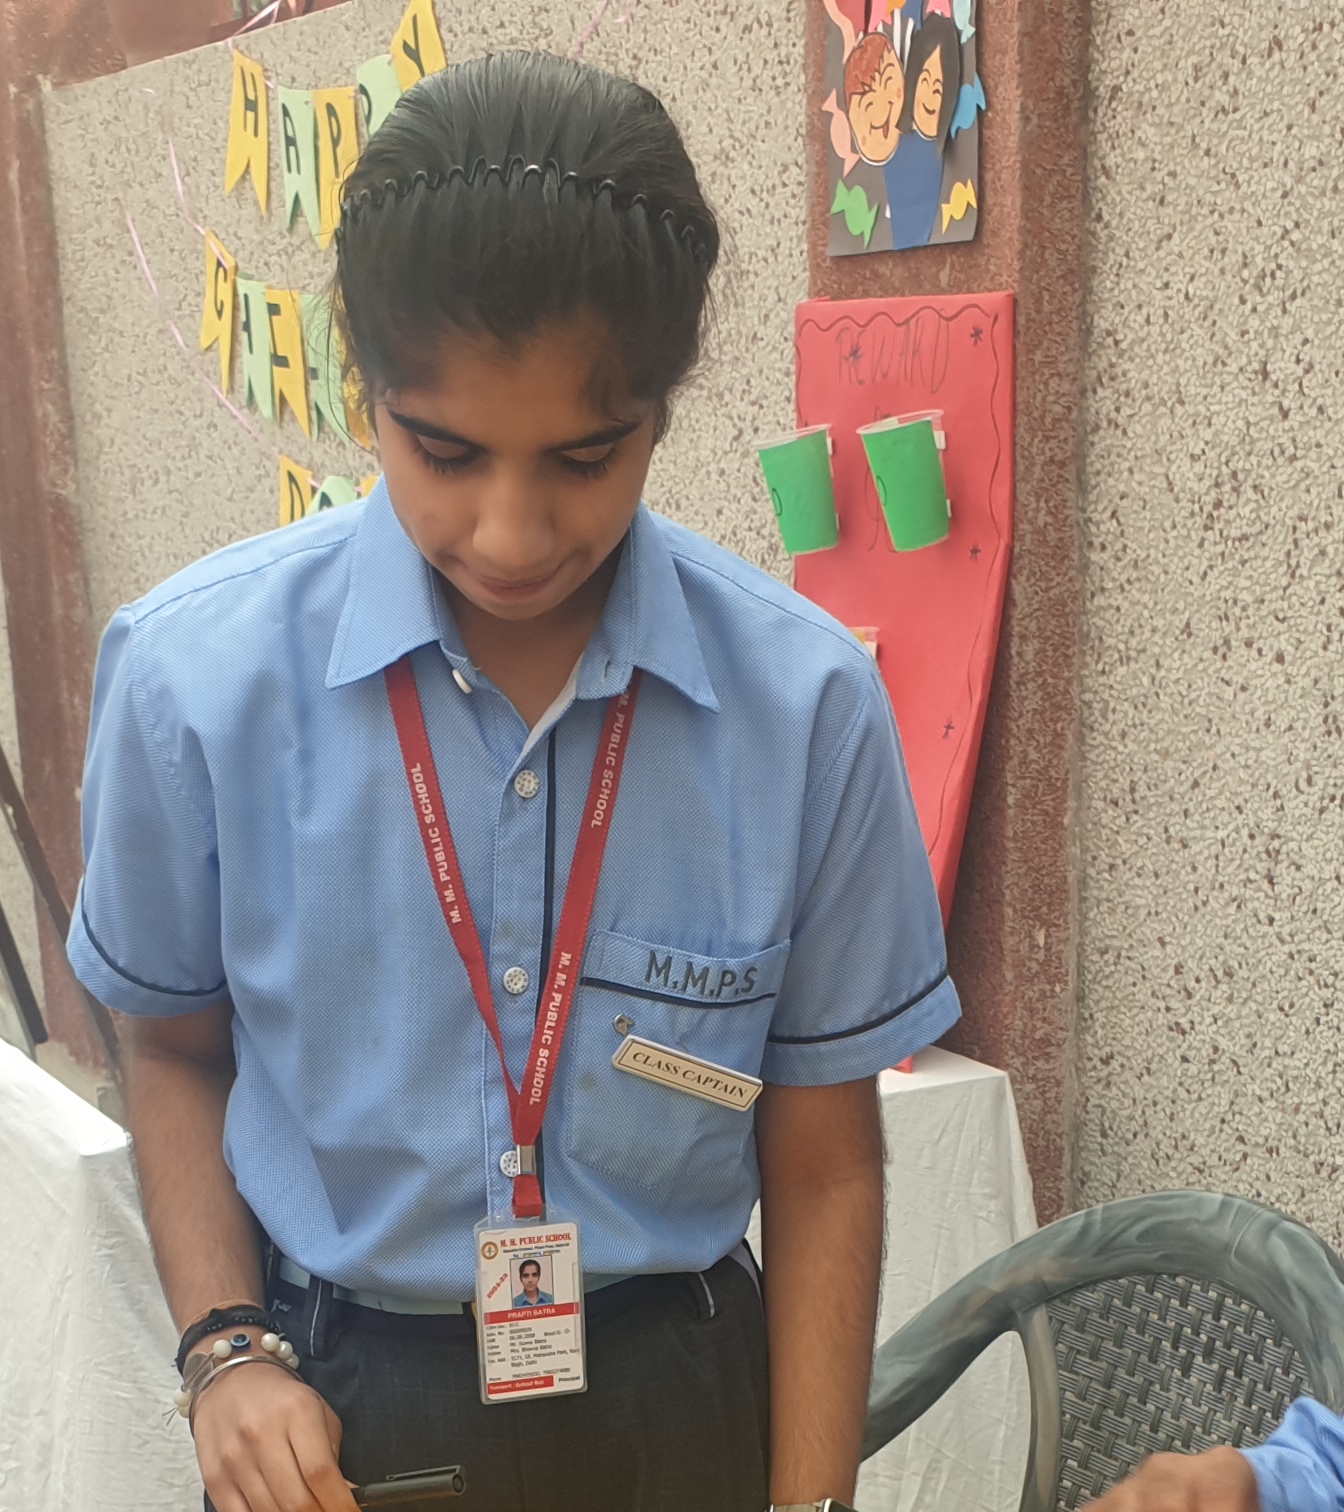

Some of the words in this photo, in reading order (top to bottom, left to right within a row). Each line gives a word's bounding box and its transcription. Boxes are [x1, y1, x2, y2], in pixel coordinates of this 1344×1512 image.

[605, 711, 626, 767] PUBLIC
[410, 762, 437, 824] SCHOOL
[590, 768, 614, 829] SCHOOL
[428, 826, 452, 883] PUBLIC
[443, 884, 457, 903] M.
[449, 904, 463, 924] M.
[553, 972, 567, 989] M.
[558, 951, 573, 969] M.
[541, 993, 563, 1046] PUBLIC
[529, 1047, 550, 1106] SCHOOL
[632, 1051, 682, 1076] CLASS
[682, 1069, 749, 1099] CAPTAIN
[519, 1235, 544, 1246] PUBLIC
[545, 1232, 572, 1243] SCHOOL
